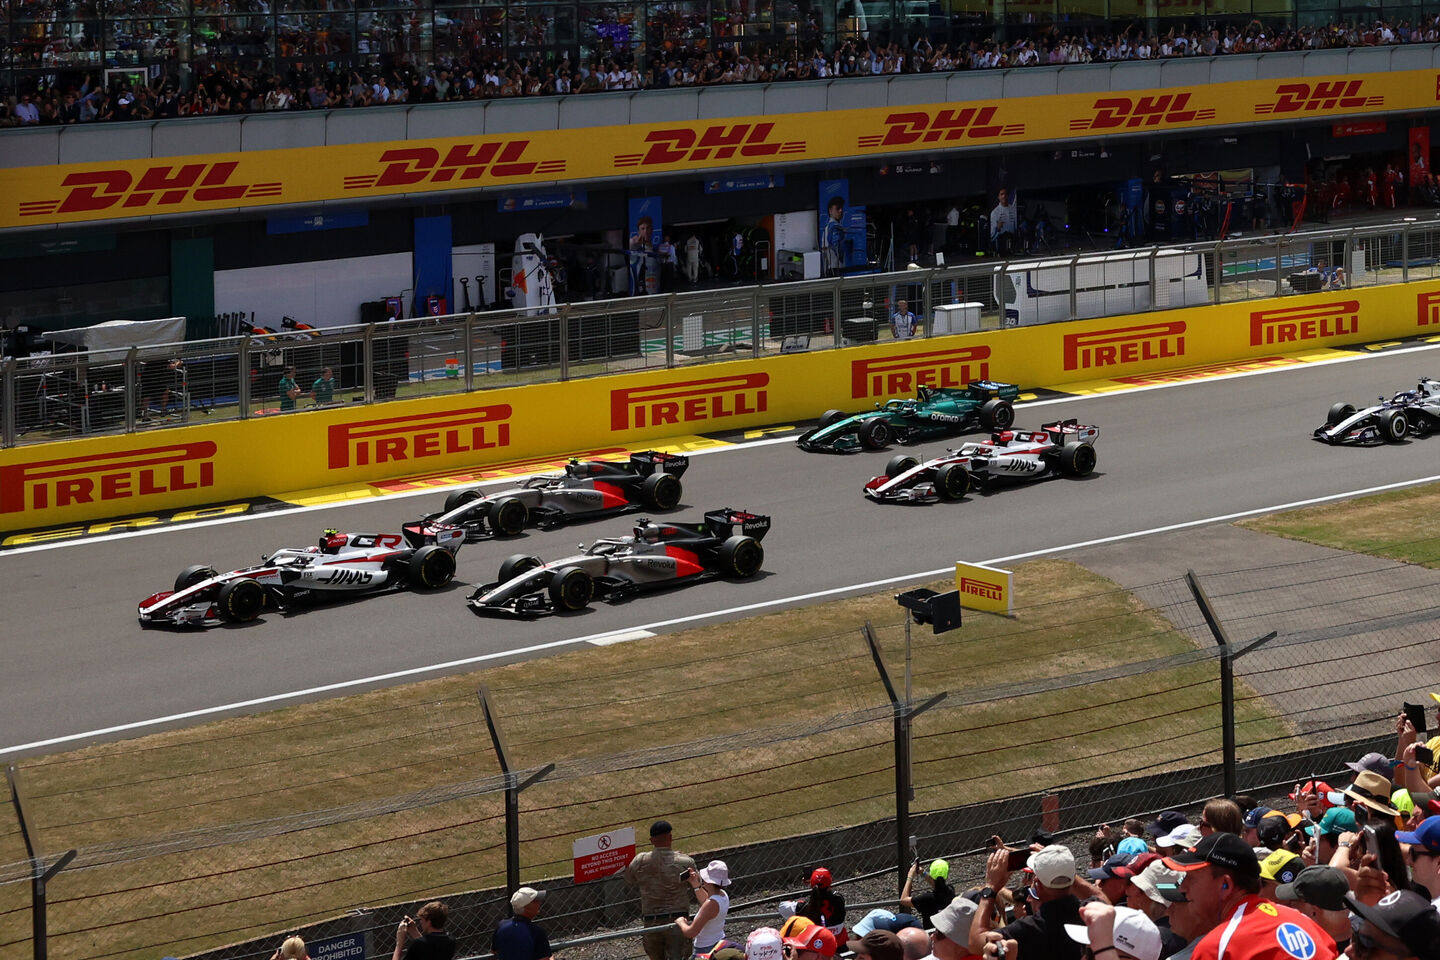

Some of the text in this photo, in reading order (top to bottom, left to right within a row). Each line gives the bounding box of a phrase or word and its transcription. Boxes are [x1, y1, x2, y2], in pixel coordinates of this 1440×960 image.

[1089, 93, 1197, 127] DHL
[1272, 80, 1369, 113] DHL
[641, 123, 783, 164] DHL
[881, 107, 1003, 147] DHL
[375, 141, 537, 187] DHL
[57, 161, 250, 213] DHL
[1250, 301, 1359, 346] PIRELLI
[1064, 321, 1186, 370] PIRELLI
[852, 346, 991, 399] PIRELLI
[611, 373, 769, 431] PIRELLI
[931, 413, 959, 423] aramco
[328, 404, 512, 469] PIRELLI
[0, 441, 217, 514] PIRELLI
[664, 460, 686, 469] Revolut
[744, 520, 768, 531] Revolut
[648, 558, 675, 570] Revolut
[961, 578, 1002, 600] PIRELLI
[319, 939, 355, 953] DANGER
[1285, 926, 1309, 958] hp
